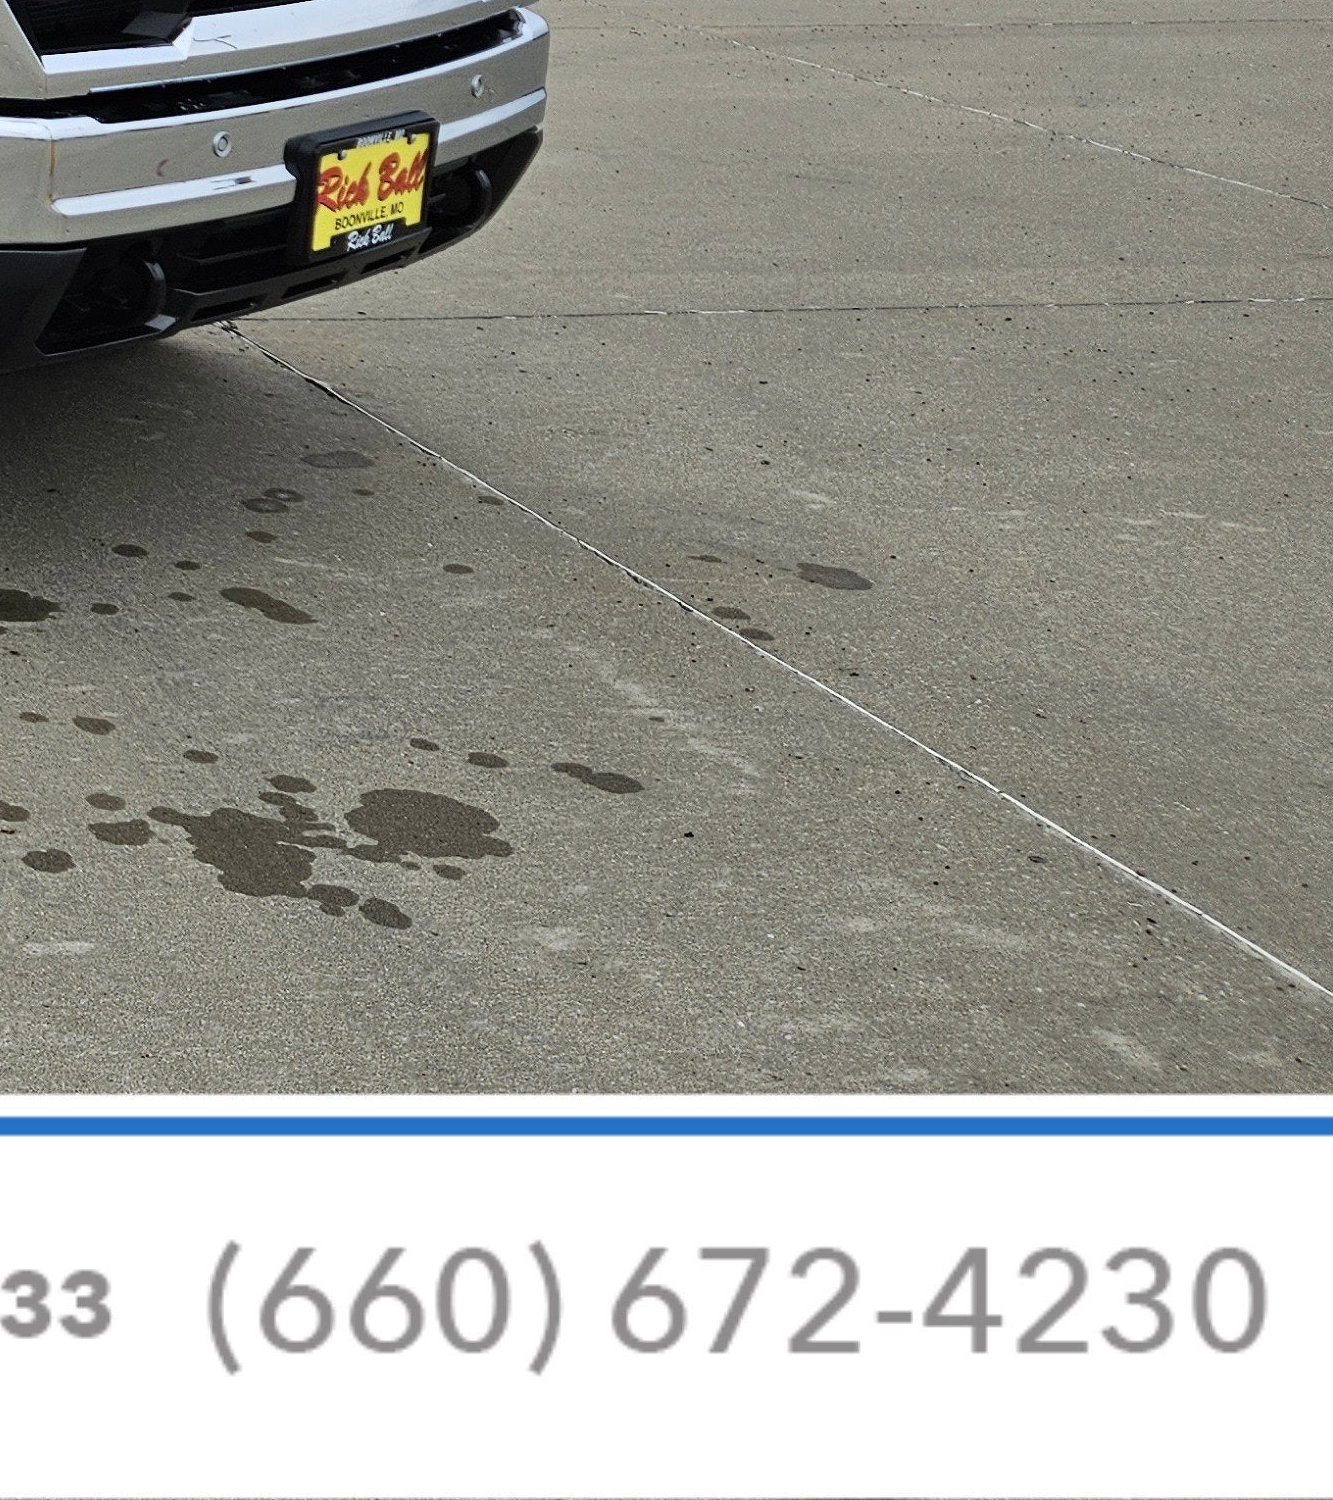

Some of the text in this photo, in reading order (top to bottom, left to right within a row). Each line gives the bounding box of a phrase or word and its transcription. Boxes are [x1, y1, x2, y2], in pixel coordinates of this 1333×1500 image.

[316, 148, 429, 213] Rick Ball
[391, 201, 405, 216] MO
[347, 222, 395, 251] Rick Ball
